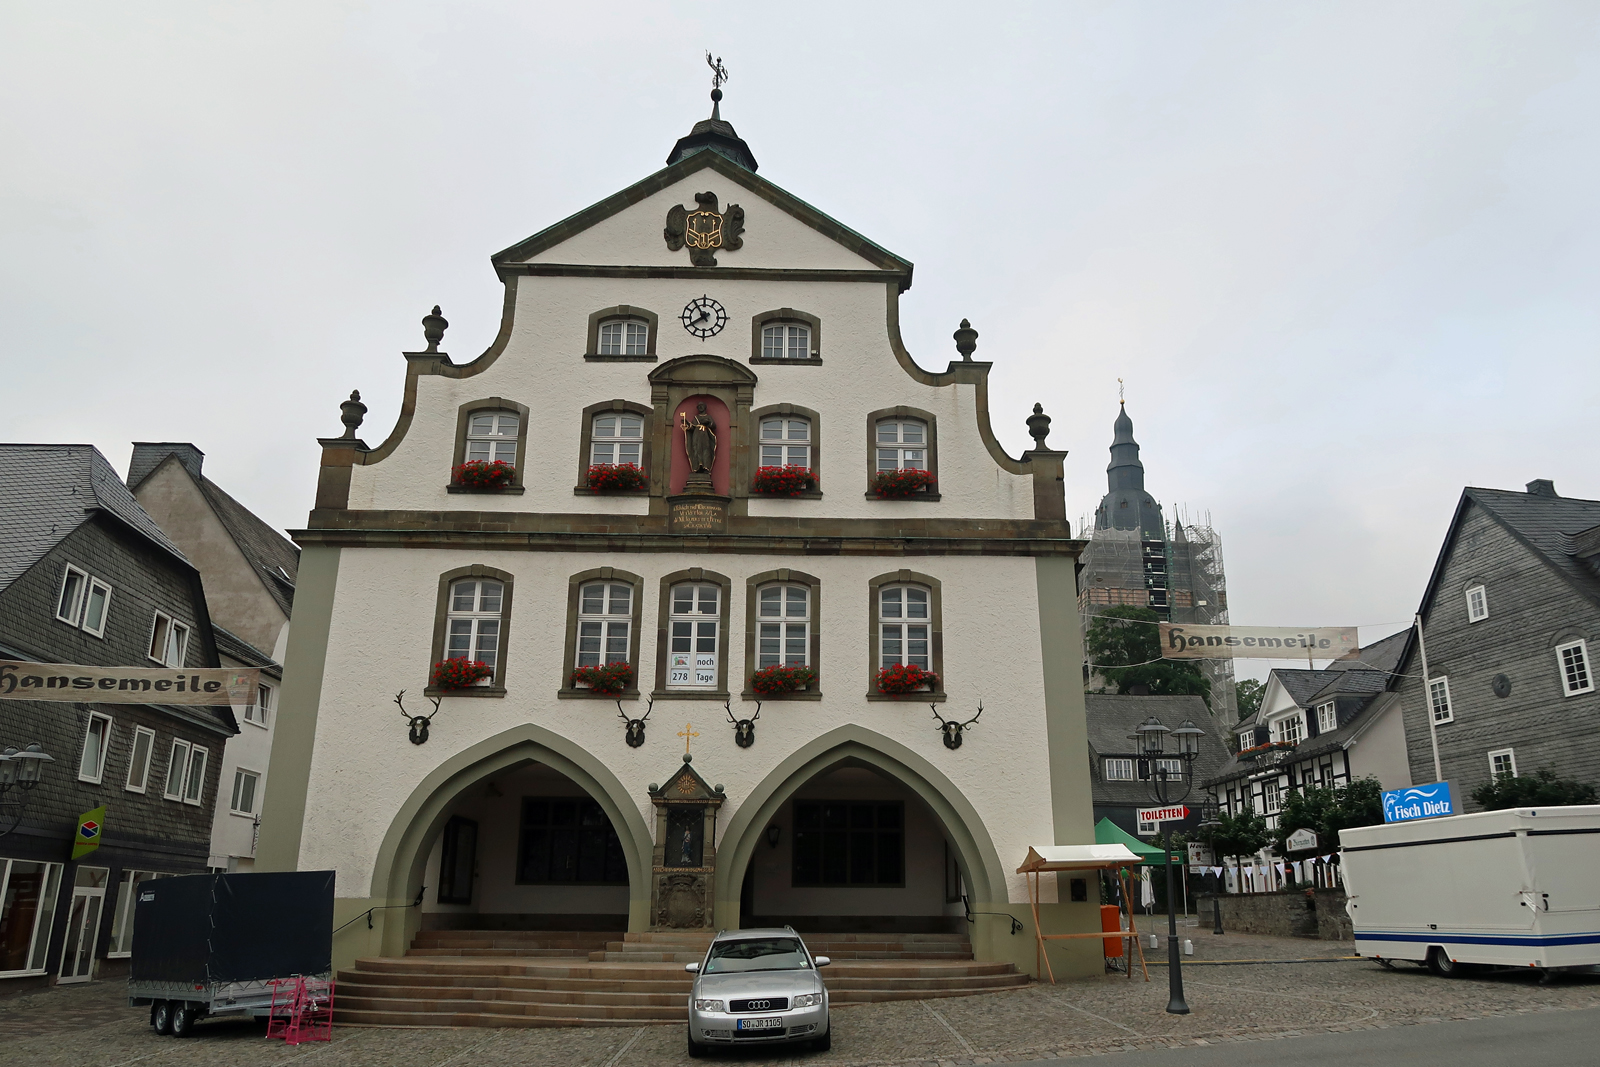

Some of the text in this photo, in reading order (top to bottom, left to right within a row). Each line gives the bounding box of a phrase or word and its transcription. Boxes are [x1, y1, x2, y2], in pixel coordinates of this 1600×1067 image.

[672, 672, 714, 682] 278 Tage
[1141, 807, 1183, 821] TOILETTEN
[1394, 800, 1451, 819] Fisch Dietz
